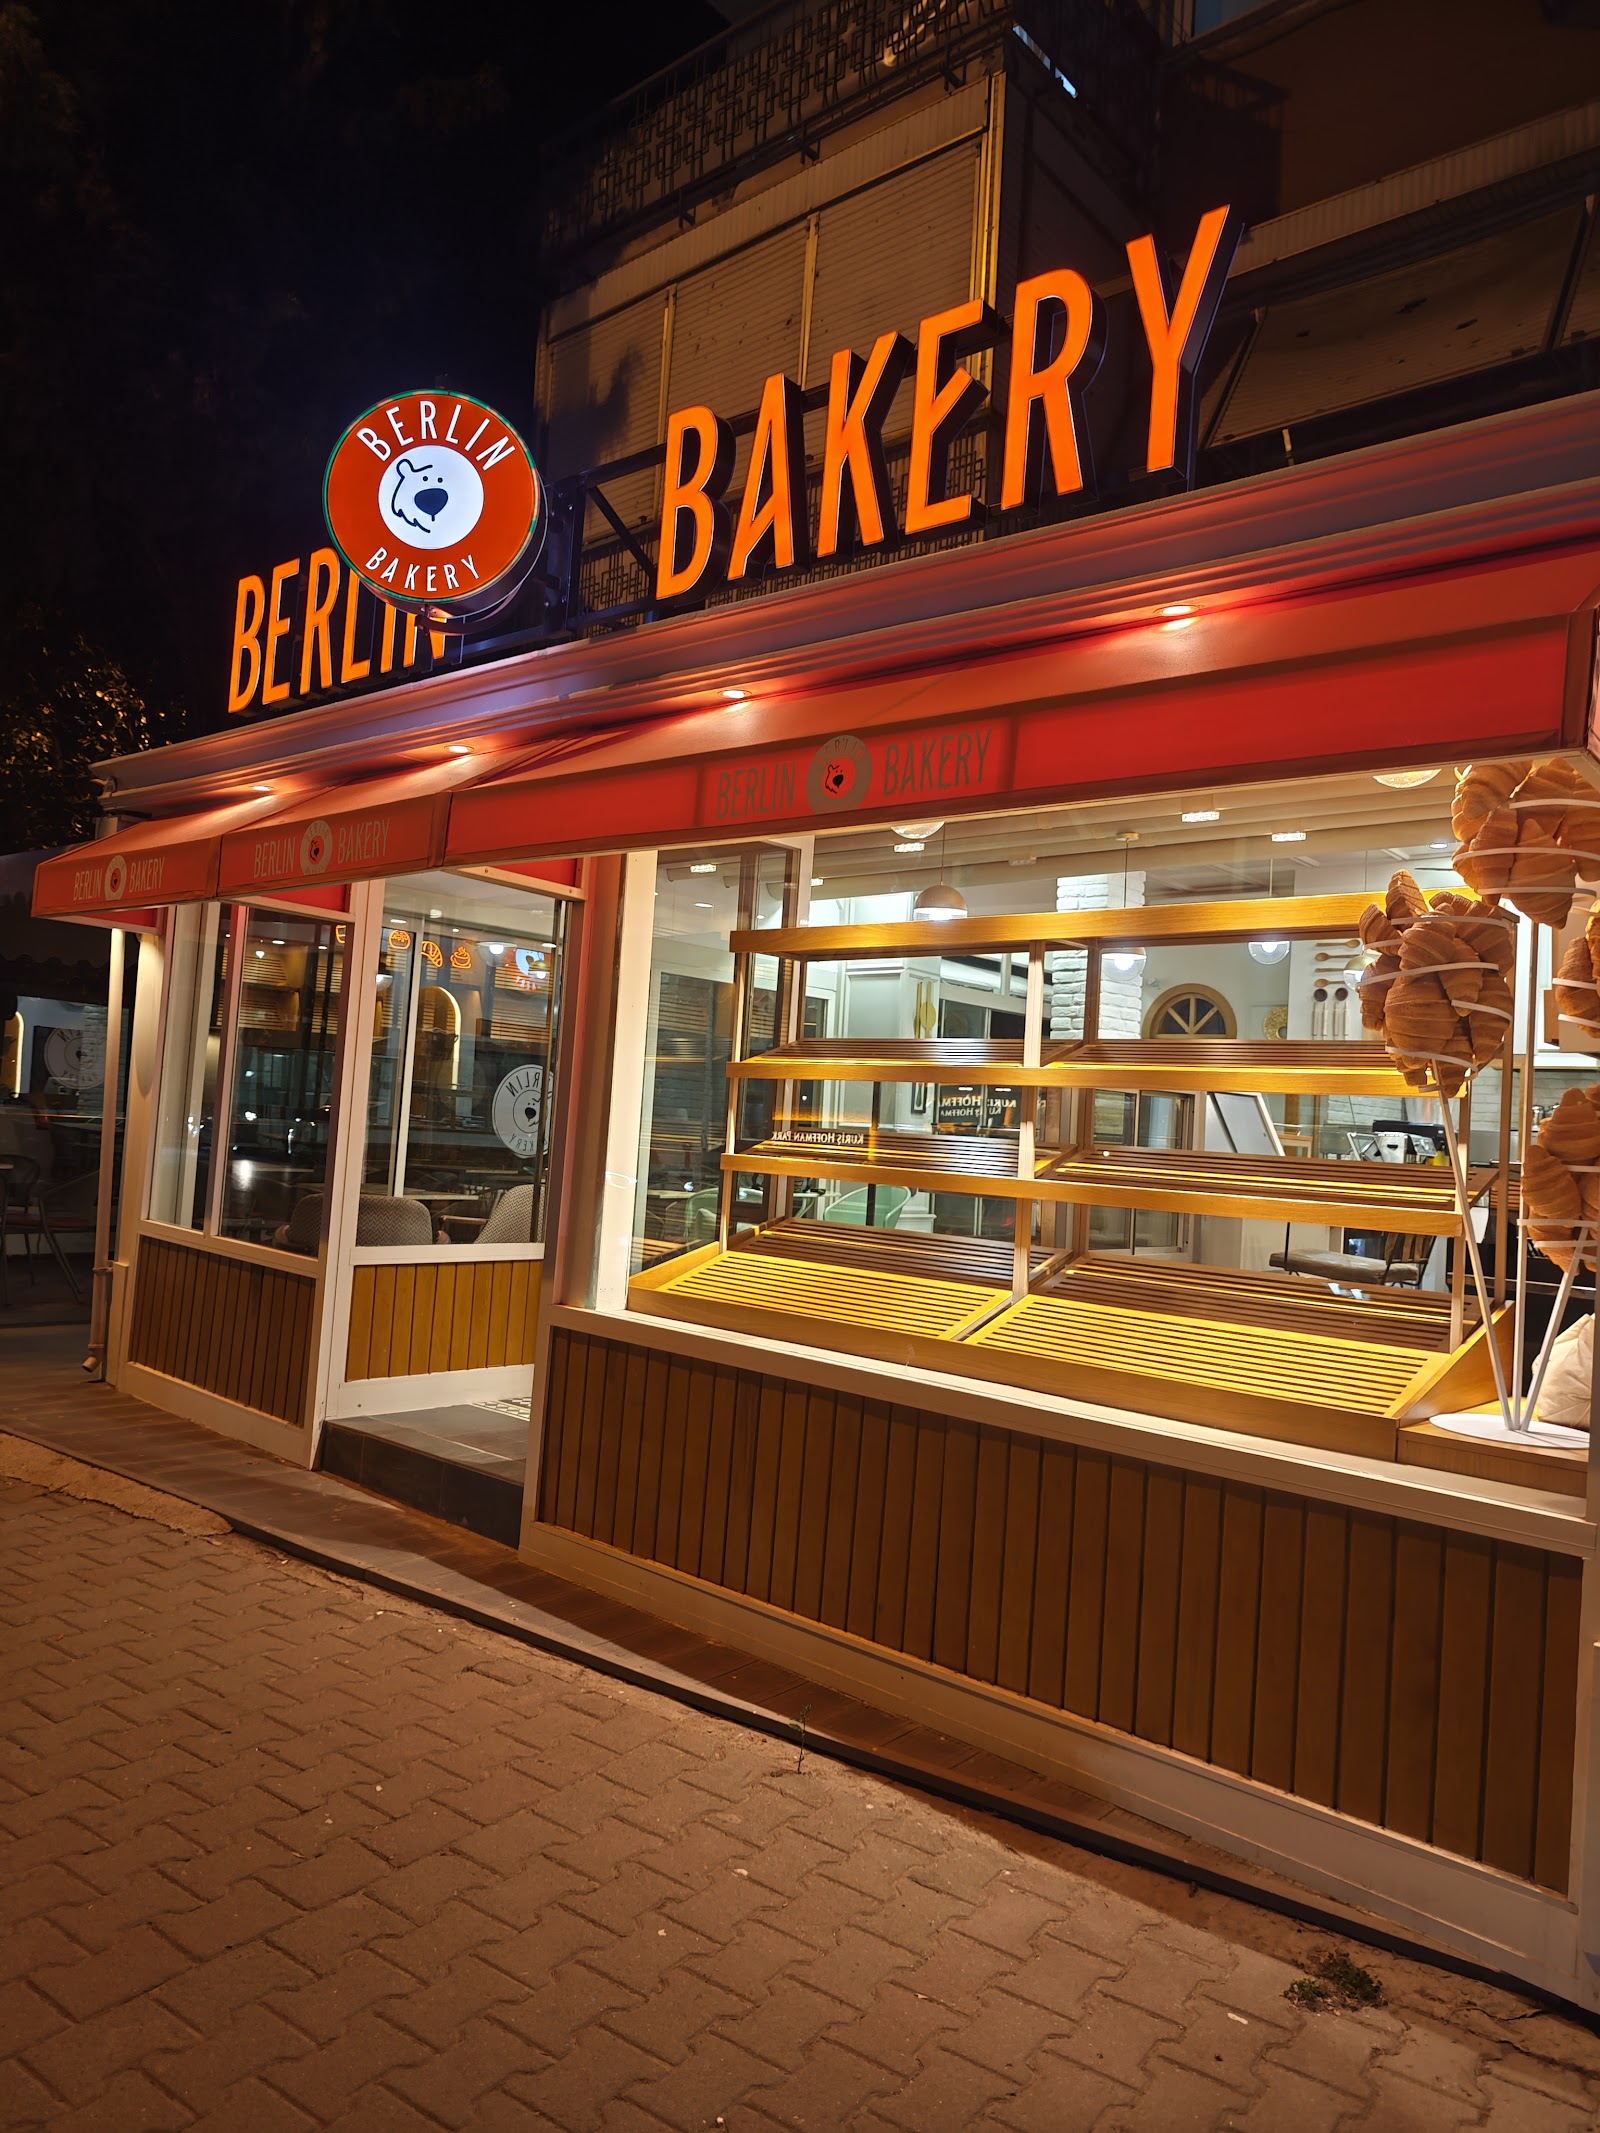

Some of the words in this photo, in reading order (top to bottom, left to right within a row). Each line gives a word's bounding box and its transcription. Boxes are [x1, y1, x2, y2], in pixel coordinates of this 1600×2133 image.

[228, 547, 446, 713] BERL
[656, 204, 1230, 600] BAKERY
[356, 400, 516, 471] BERLIN
[365, 547, 479, 592] BAKERY
[716, 760, 797, 820] BERLIN
[883, 728, 993, 797] BAKERY
[74, 869, 103, 901] BERLIN
[129, 857, 165, 893] BAKERY
[253, 837, 296, 878] BERLIN
[337, 817, 391, 864] BAKERY
